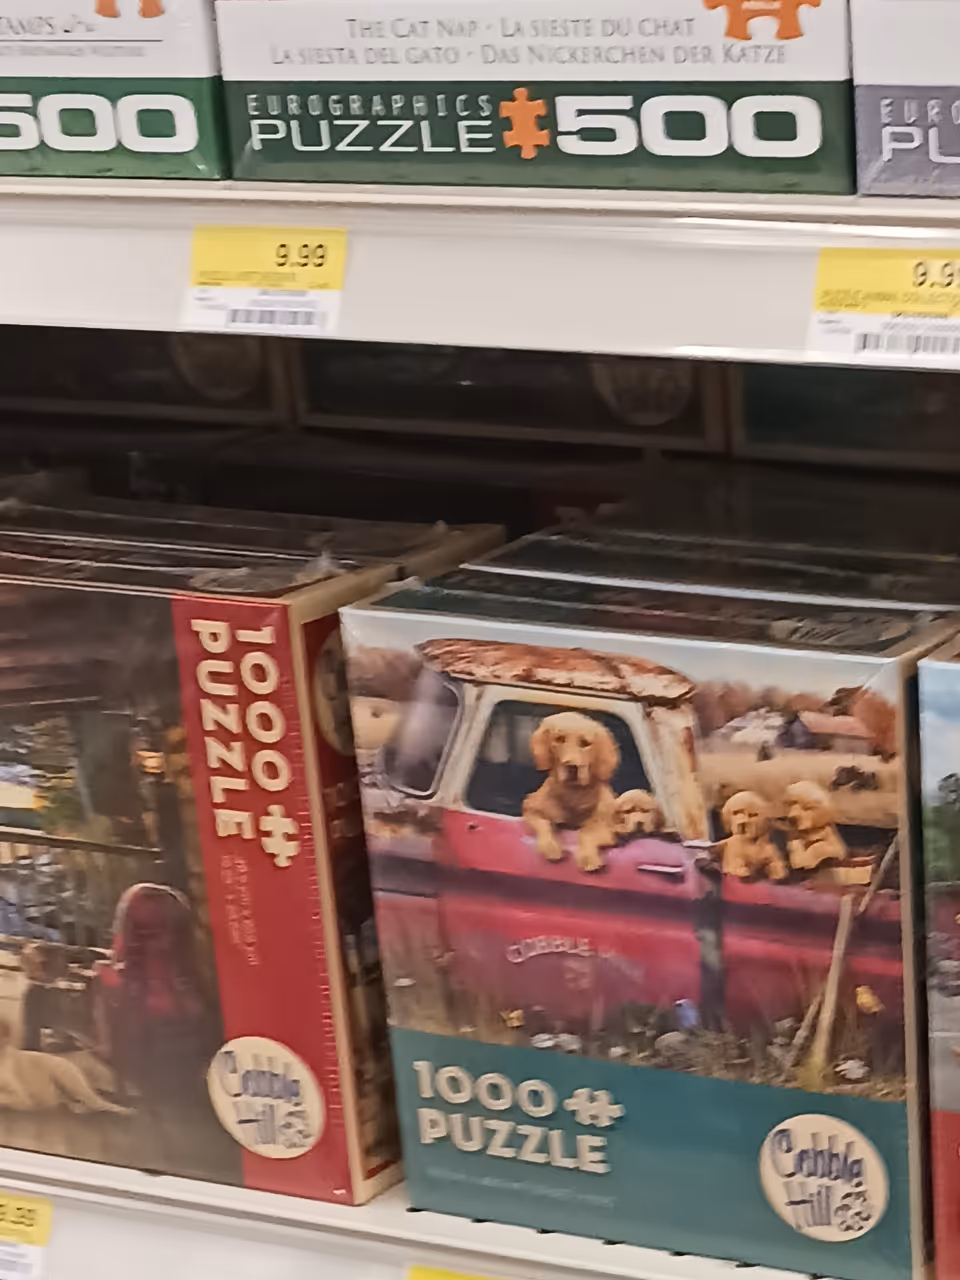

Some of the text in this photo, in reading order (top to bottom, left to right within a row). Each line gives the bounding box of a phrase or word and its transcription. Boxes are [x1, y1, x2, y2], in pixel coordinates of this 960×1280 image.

[345, 18, 385, 39] THE
[390, 18, 430, 39] CAT
[434, 18, 479, 39] NAP
[637, 18, 696, 38] CHAT
[245, 93, 494, 117] EUROGRAPHICS
[249, 94, 824, 158] PUZZLE 500
[274, 243, 327, 268] 9.99
[190, 619, 257, 840] PUZZLE
[235, 625, 292, 793] 1000
[412, 1059, 558, 1119] 1000
[416, 1107, 613, 1175] PUZZLE
[768, 1127, 866, 1185] Cobble
